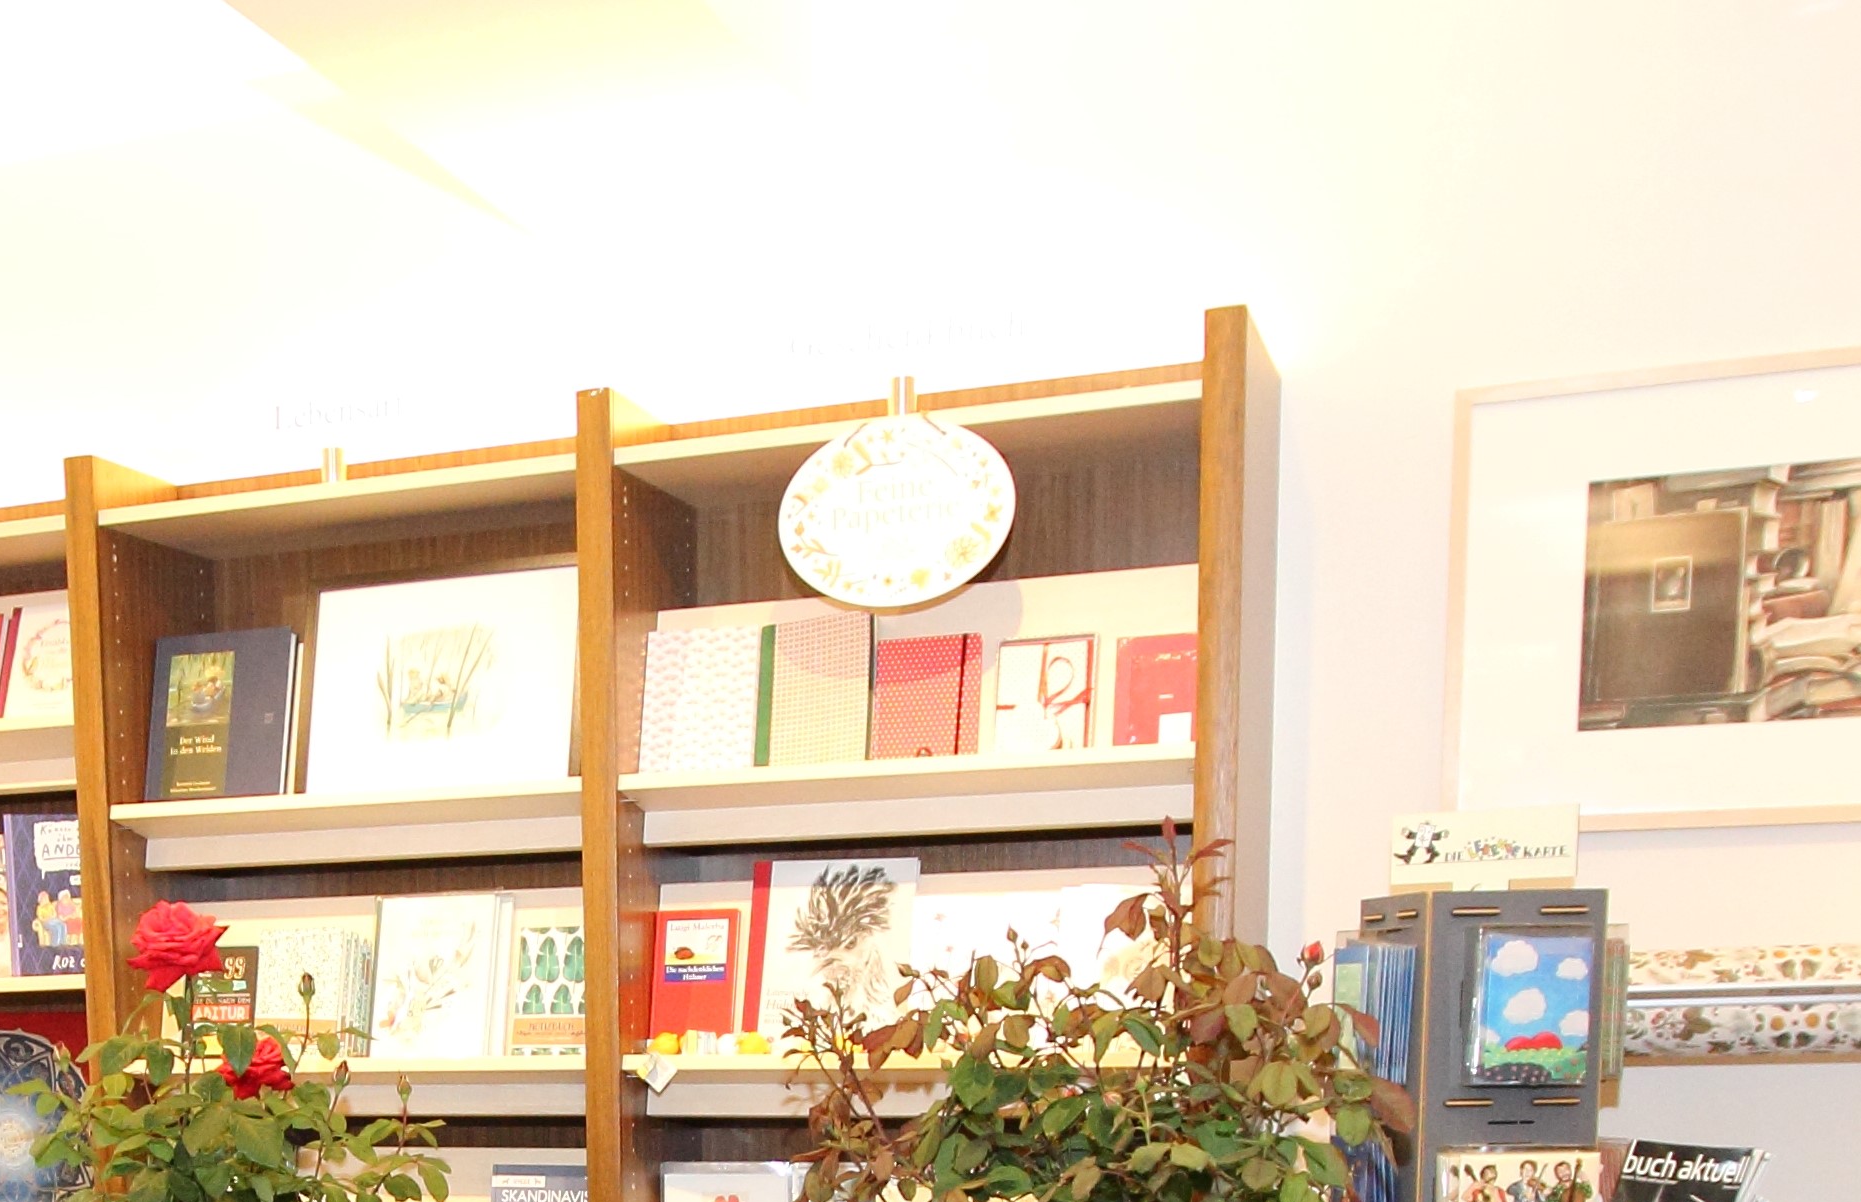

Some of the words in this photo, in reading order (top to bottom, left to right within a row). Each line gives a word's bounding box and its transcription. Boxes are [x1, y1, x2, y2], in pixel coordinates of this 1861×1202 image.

[855, 477, 932, 505] Feine
[828, 500, 962, 535] Papeterie
[1444, 851, 1464, 862] DIE
[1523, 845, 1568, 858] KARTE
[224, 956, 247, 980] 99
[192, 1006, 246, 1021] ABITUR
[1622, 1139, 1676, 1178] buch
[1678, 1153, 1751, 1184] aktuell
